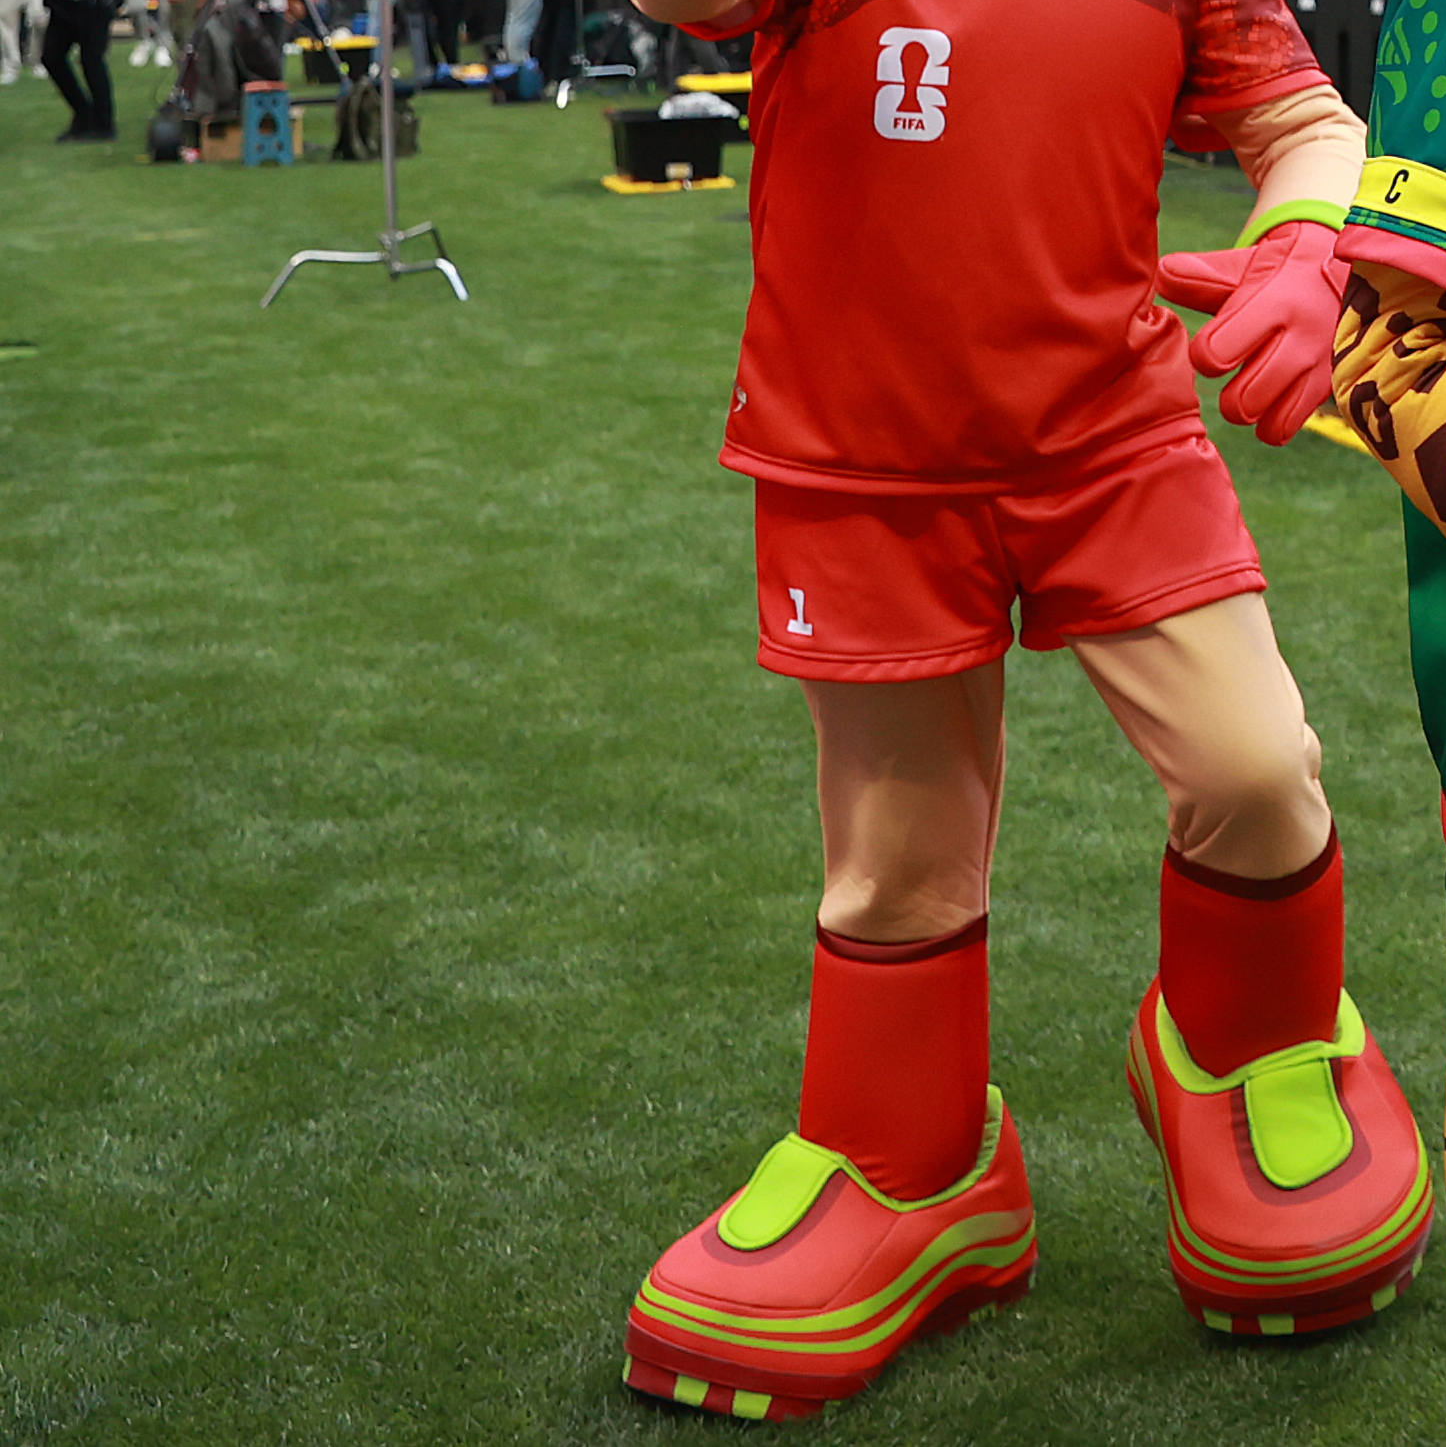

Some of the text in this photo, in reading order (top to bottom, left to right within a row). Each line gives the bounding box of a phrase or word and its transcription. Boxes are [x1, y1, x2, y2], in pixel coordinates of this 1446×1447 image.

[893, 117, 925, 131] FIFA
[1385, 169, 1409, 204] C
[787, 587, 813, 636] 1
